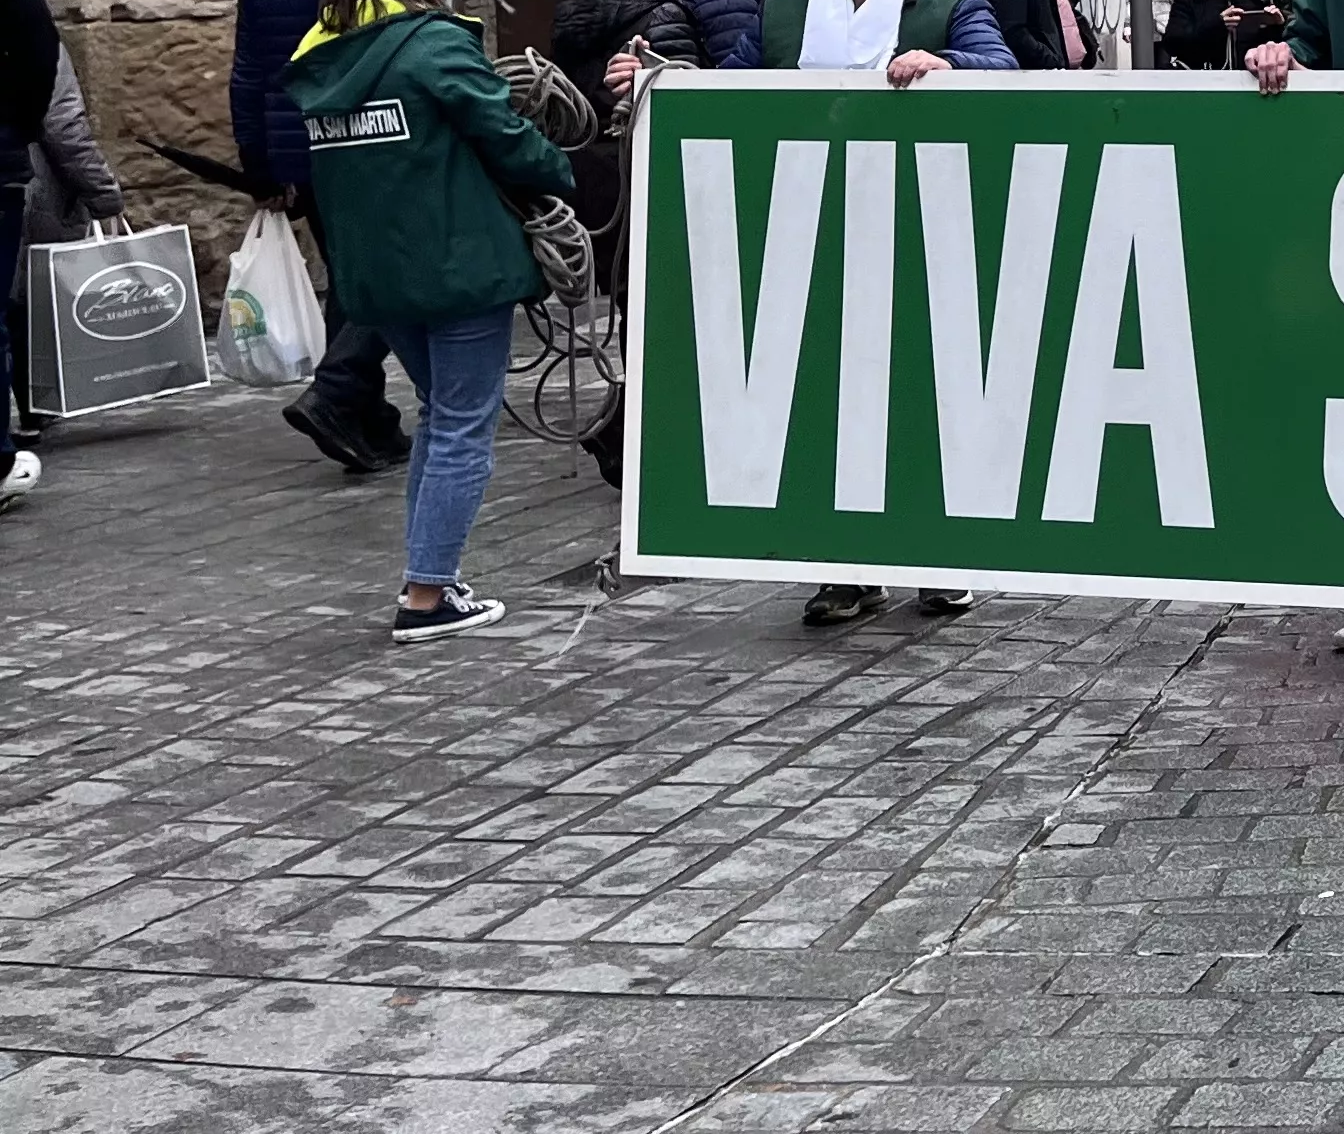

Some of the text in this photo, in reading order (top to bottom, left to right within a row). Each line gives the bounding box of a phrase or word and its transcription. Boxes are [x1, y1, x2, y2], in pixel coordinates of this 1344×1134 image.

[322, 115, 348, 139] SAN
[348, 107, 401, 137] MARTIN
[681, 138, 1215, 529] VIVA
